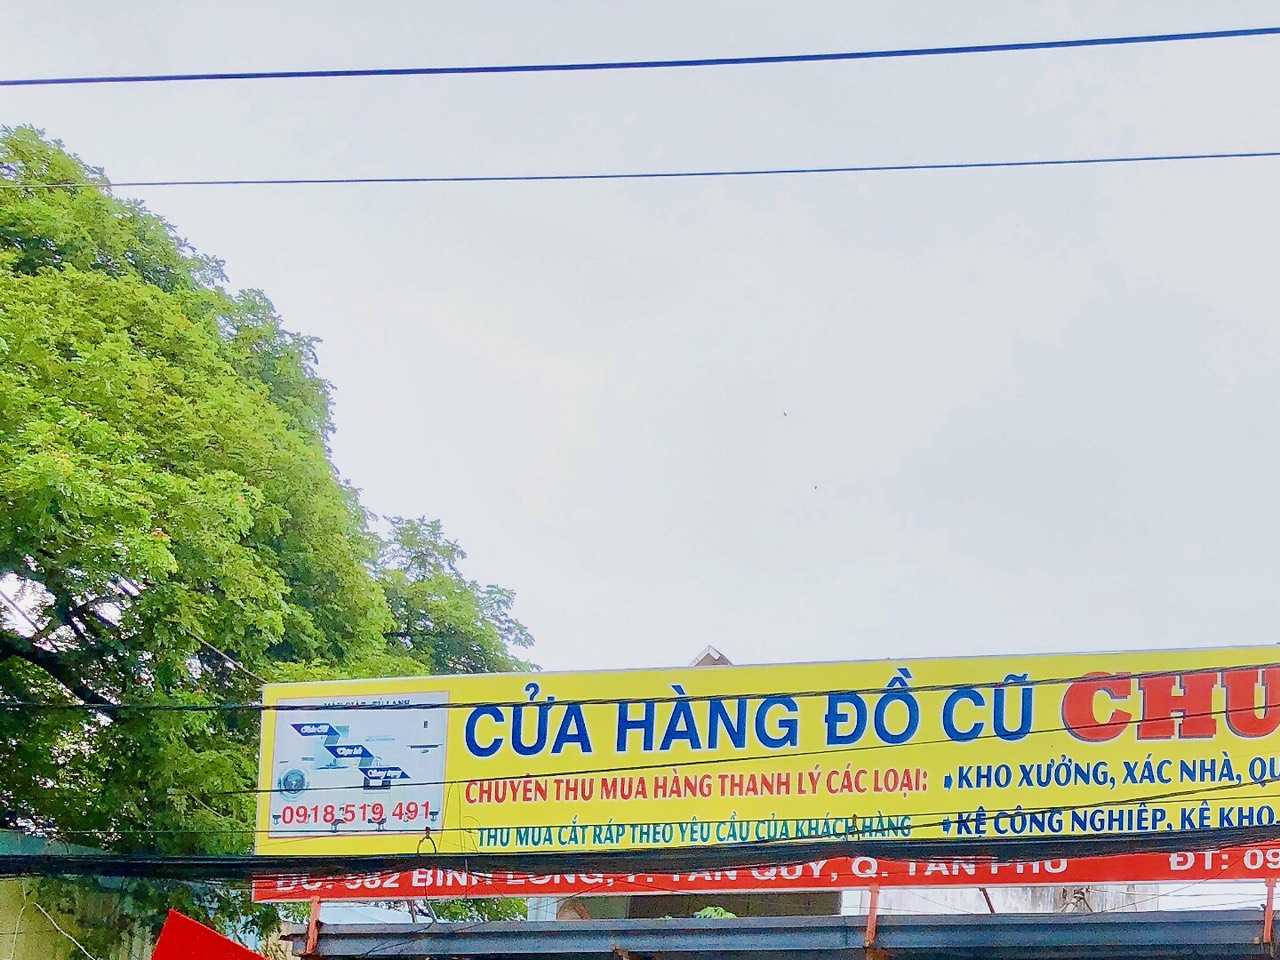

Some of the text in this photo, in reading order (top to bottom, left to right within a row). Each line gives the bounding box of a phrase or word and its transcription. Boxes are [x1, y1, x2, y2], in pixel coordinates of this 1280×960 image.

[465, 682, 593, 758] CỬA
[616, 684, 799, 752] HÀNG
[824, 667, 920, 746] ĐỒ
[942, 673, 1034, 743] CŨ
[554, 778, 595, 801] THU
[600, 776, 649, 800] MUA
[653, 768, 713, 799] HÀNG
[718, 773, 791, 798] THANH
[797, 764, 822, 796] LÝ
[826, 763, 868, 794] CÁC
[873, 768, 928, 799] LOẠI:
[957, 763, 1012, 789] KHO
[1017, 754, 1116, 789] XƯỞNG,
[1122, 753, 1173, 785] XÁC
[1179, 751, 1242, 787] NHÀ,
[281, 800, 432, 825] 0918 519 491
[478, 826, 510, 848] THU
[515, 826, 551, 847] MUA
[557, 814, 589, 846] CẮT
[592, 817, 626, 845] RÁP
[629, 823, 675, 845] THEO
[679, 816, 711, 844] YÊU
[715, 811, 751, 843] CẦU
[754, 812, 790, 842] CỦA
[863, 810, 912, 838] HÀNG
[993, 804, 1065, 836] CÔNG
[852, 856, 889, 878] Q.
[1169, 850, 1229, 871] ĐT:
